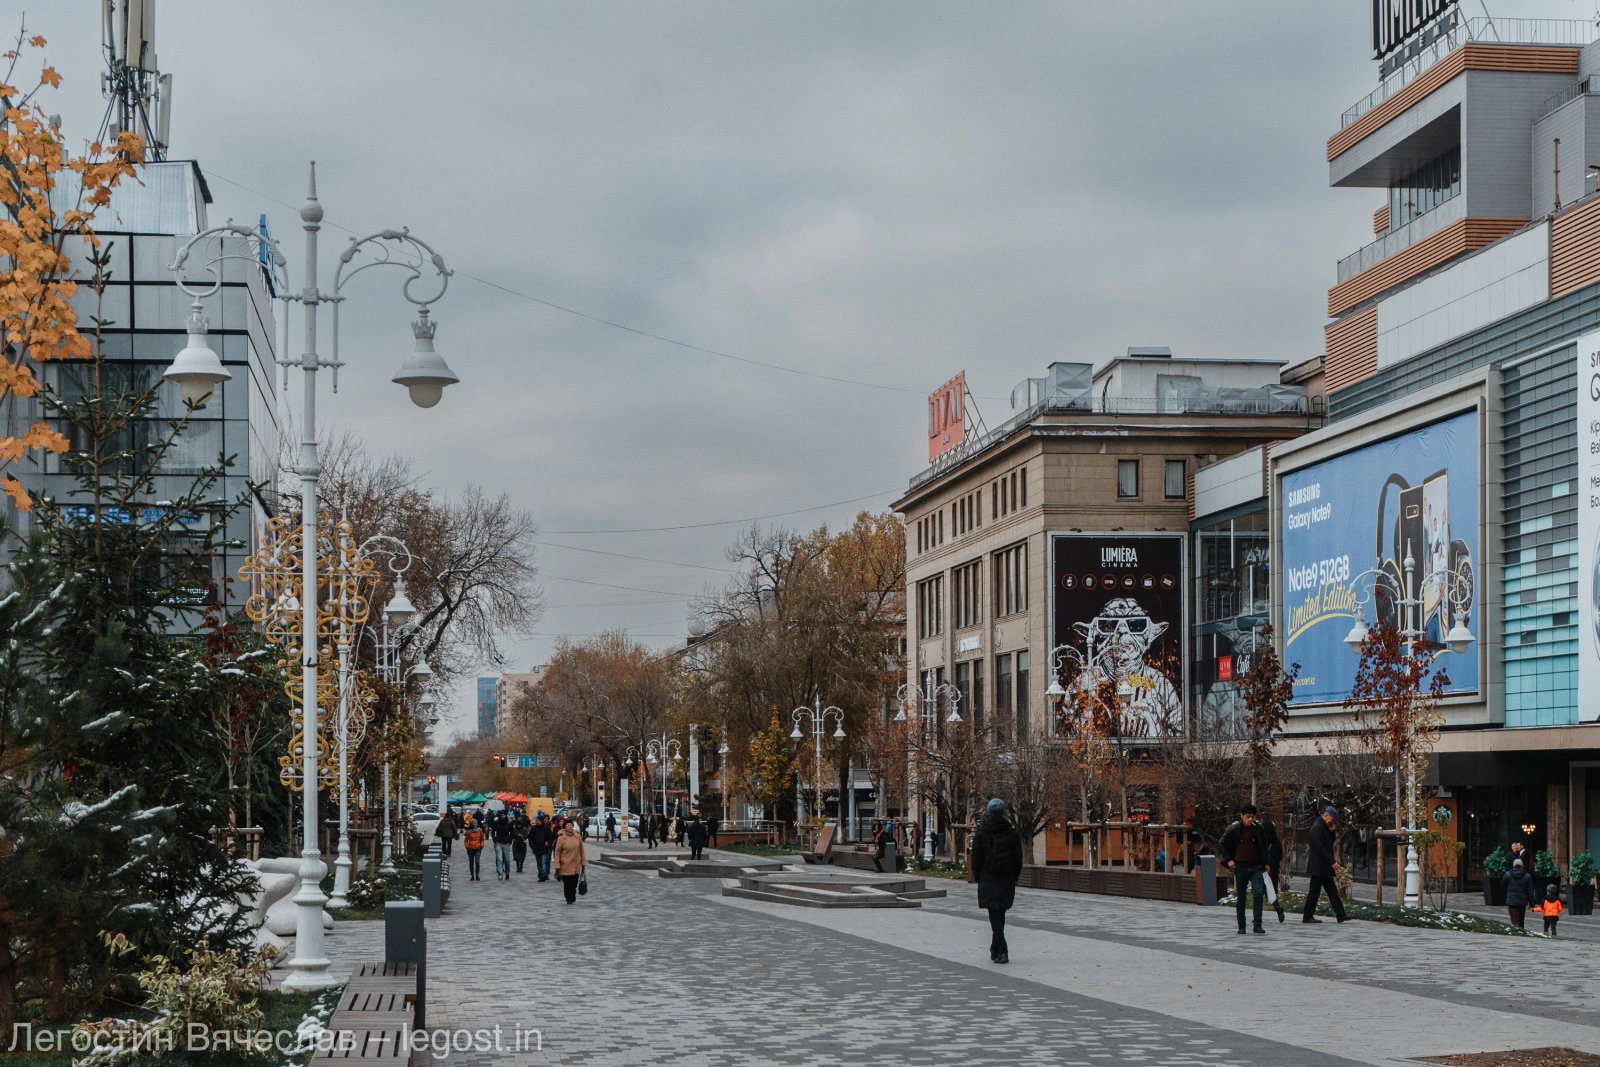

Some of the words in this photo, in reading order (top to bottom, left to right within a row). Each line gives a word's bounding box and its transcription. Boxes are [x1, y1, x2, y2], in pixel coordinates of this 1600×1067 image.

[1288, 482, 1320, 508] SAMSUNG
[1288, 510, 1310, 530] Galaxy
[1311, 502, 1331, 523] Note9
[1288, 562, 1318, 593] Note9
[1319, 555, 1350, 586] 512GB
[1287, 583, 1322, 636] Limited
[1322, 579, 1357, 613] Edition
